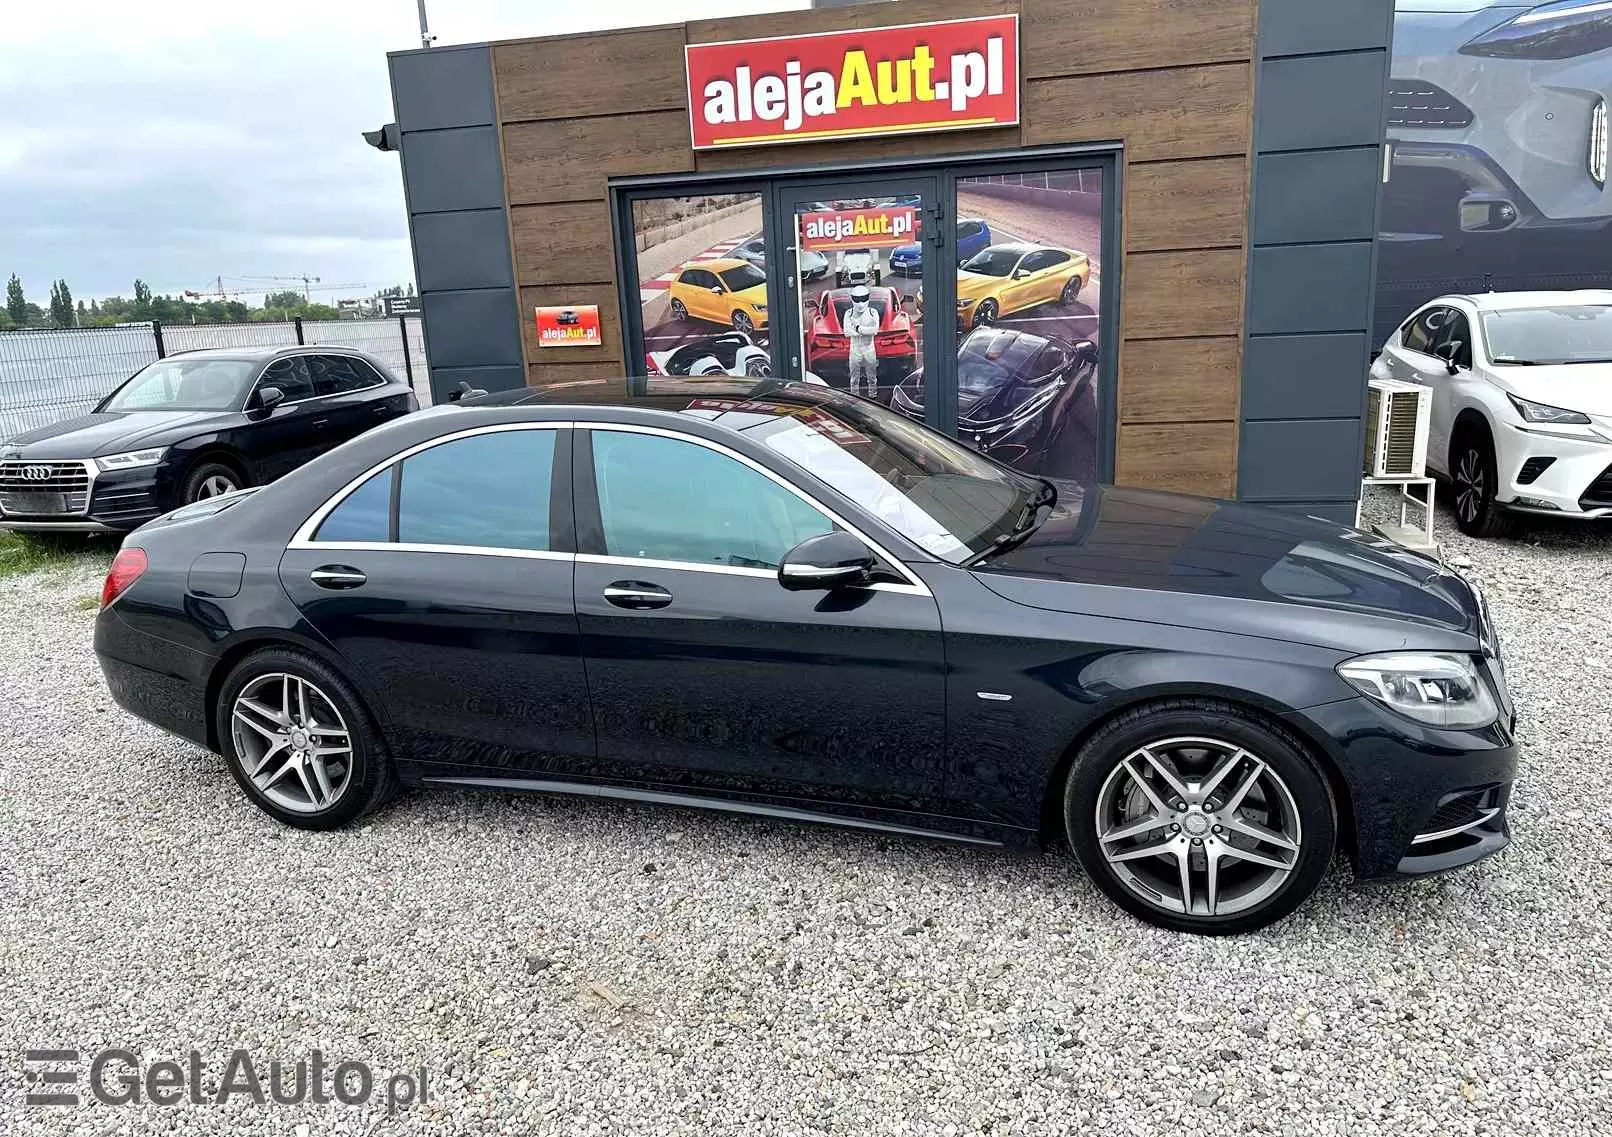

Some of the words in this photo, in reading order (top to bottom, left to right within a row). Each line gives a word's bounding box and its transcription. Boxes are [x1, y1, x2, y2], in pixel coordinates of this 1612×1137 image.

[703, 37, 1004, 130] alejaAut.pl
[806, 211, 912, 241] alejaAut.pl
[542, 327, 597, 341] alejaAut.pl
